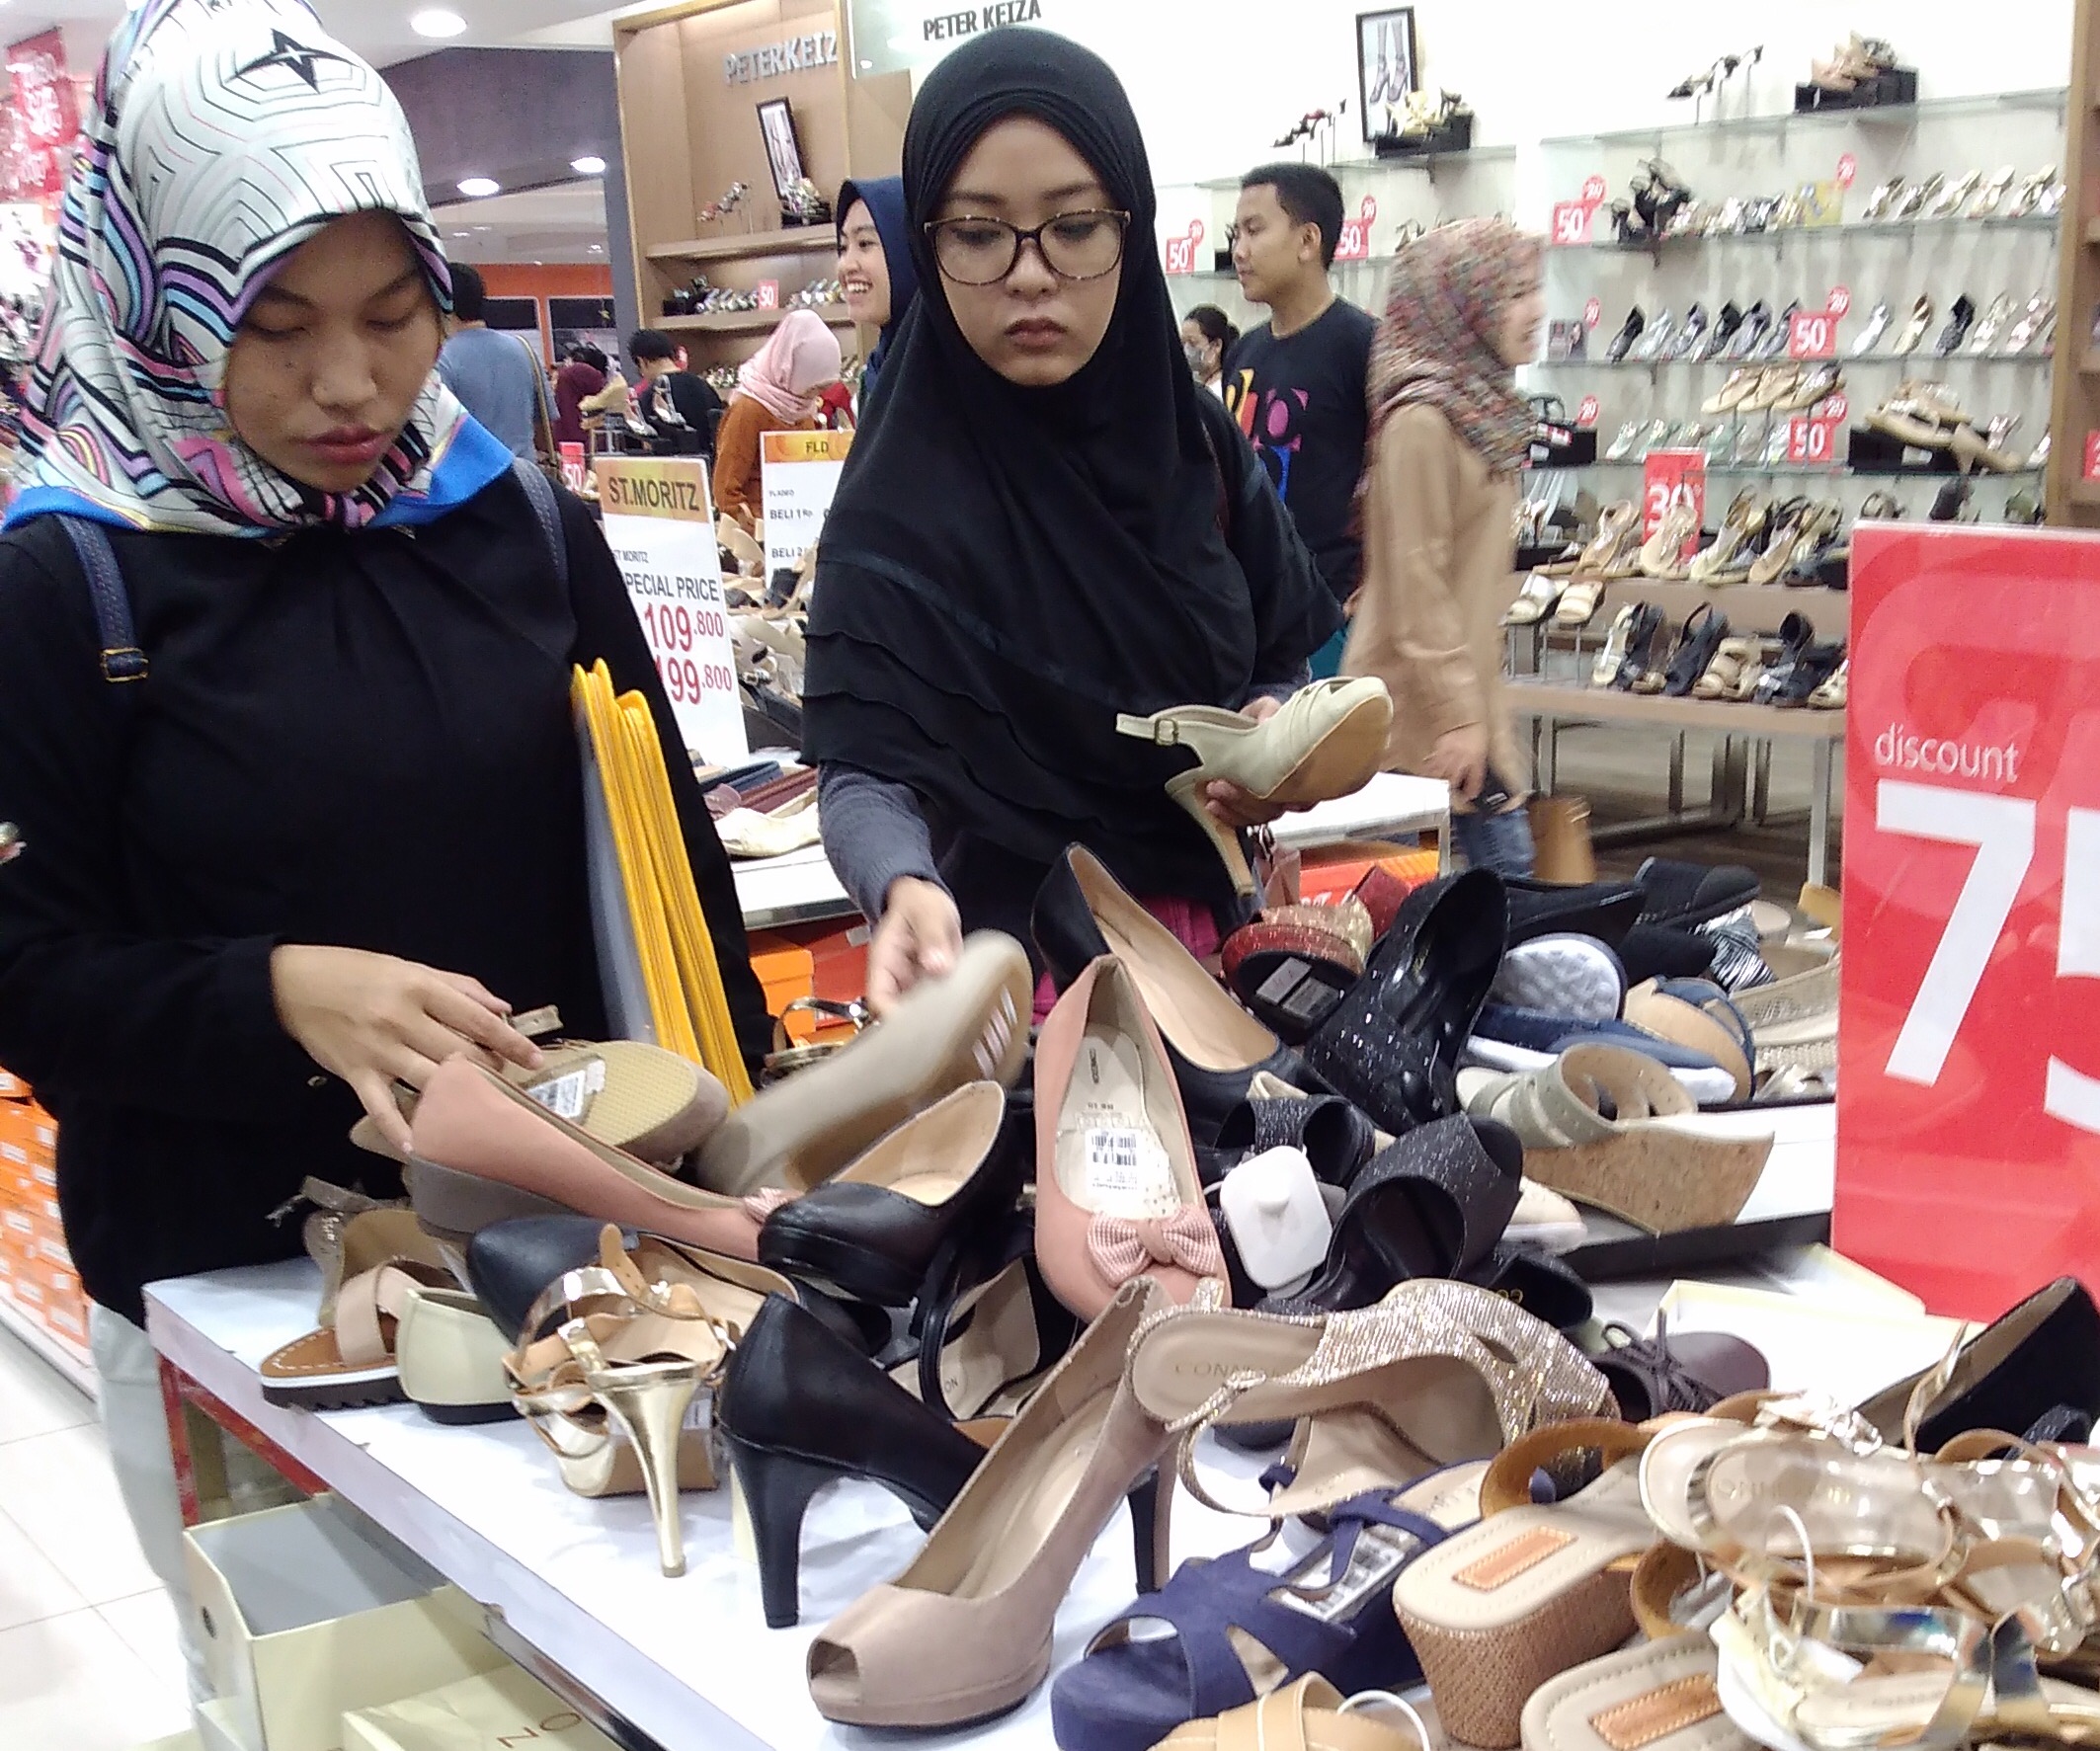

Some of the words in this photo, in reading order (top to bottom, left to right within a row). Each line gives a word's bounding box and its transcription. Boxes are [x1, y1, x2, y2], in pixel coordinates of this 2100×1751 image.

[924, 11, 978, 40] PETER
[983, 0, 1042, 30] KEIZA
[723, 31, 839, 86] PETERKEIZ
[761, 285, 774, 307] 50
[1796, 317, 1827, 353] 50
[1794, 422, 1826, 458] 50
[608, 476, 700, 512] ST.MORITZ
[770, 509, 794, 519] BELI
[622, 550, 649, 564] MORITZ
[771, 547, 795, 558] BELI
[623, 572, 675, 597] PECIAL
[676, 576, 720, 601] PRICE
[1875, 721, 2018, 783] discount
